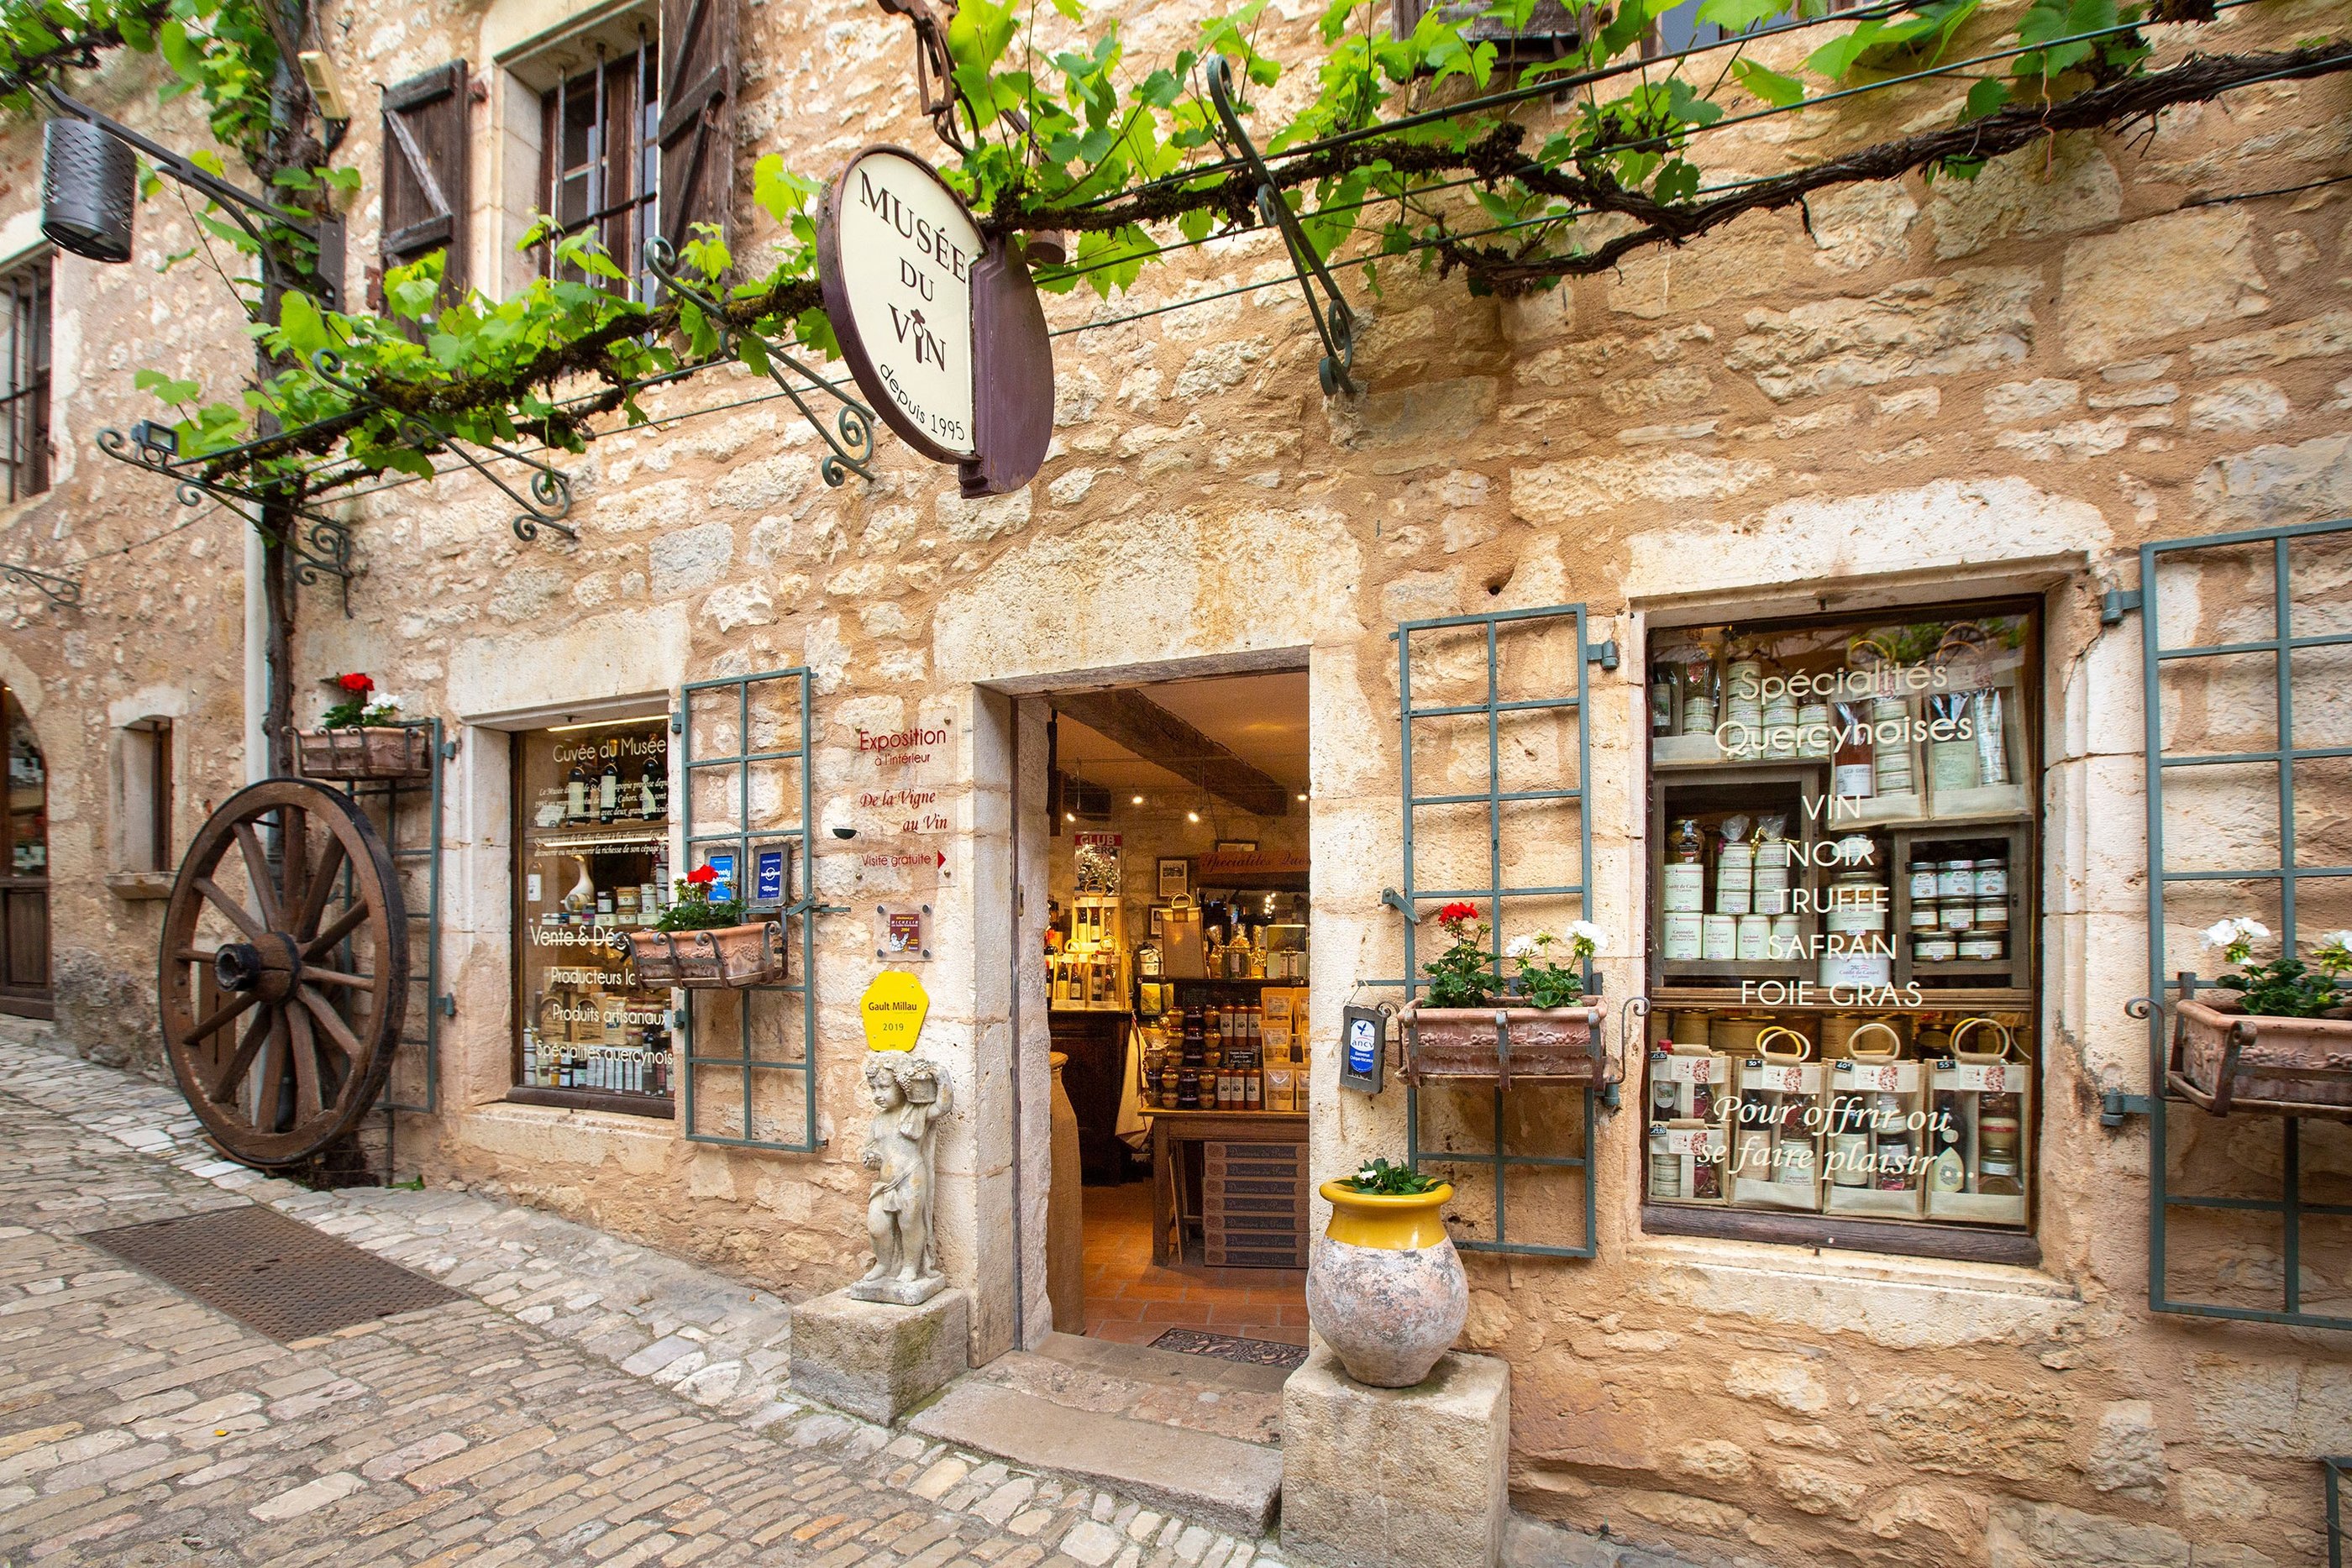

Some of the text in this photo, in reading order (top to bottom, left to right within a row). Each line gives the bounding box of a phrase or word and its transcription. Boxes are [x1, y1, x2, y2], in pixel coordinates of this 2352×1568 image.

[859, 168, 966, 283] MUSÉE
[900, 257, 934, 302] DU
[888, 303, 945, 371] VIN
[880, 364, 965, 441] depuis 1995
[1738, 659, 1948, 704] Spécialités
[553, 736, 666, 763] Cuvée du Musée
[860, 728, 946, 752] Exposition
[1714, 716, 1973, 756] Quercynoises
[875, 753, 930, 766] à l'intérieur
[860, 789, 936, 809] De la Vigne
[1802, 794, 1861, 821] VIN
[903, 813, 948, 831] au Vin
[601, 844, 622, 853] richesse
[622, 844, 629, 852] de
[641, 844, 659, 855] cépage
[861, 854, 931, 867] Visite gratuite
[1786, 841, 1875, 868] NOIX
[1774, 887, 1889, 914] TRUFFE
[530, 926, 574, 947] Vente
[578, 925, 589, 947] &
[1768, 934, 1897, 962] SAFRAN
[551, 967, 622, 985] Producteurs
[869, 1002, 917, 1010] Gault Millau
[1741, 980, 1923, 1008] FOIE GRAS
[553, 1004, 666, 1025] Produits artisanaux
[883, 1023, 904, 1031] 2019
[536, 1040, 601, 1060] Spécialités
[1352, 1040, 1374, 1048] ancv
[1714, 1095, 1950, 1137] Pour offrir ou
[1697, 1144, 1727, 1164] se
[1727, 1135, 1814, 1174] faire
